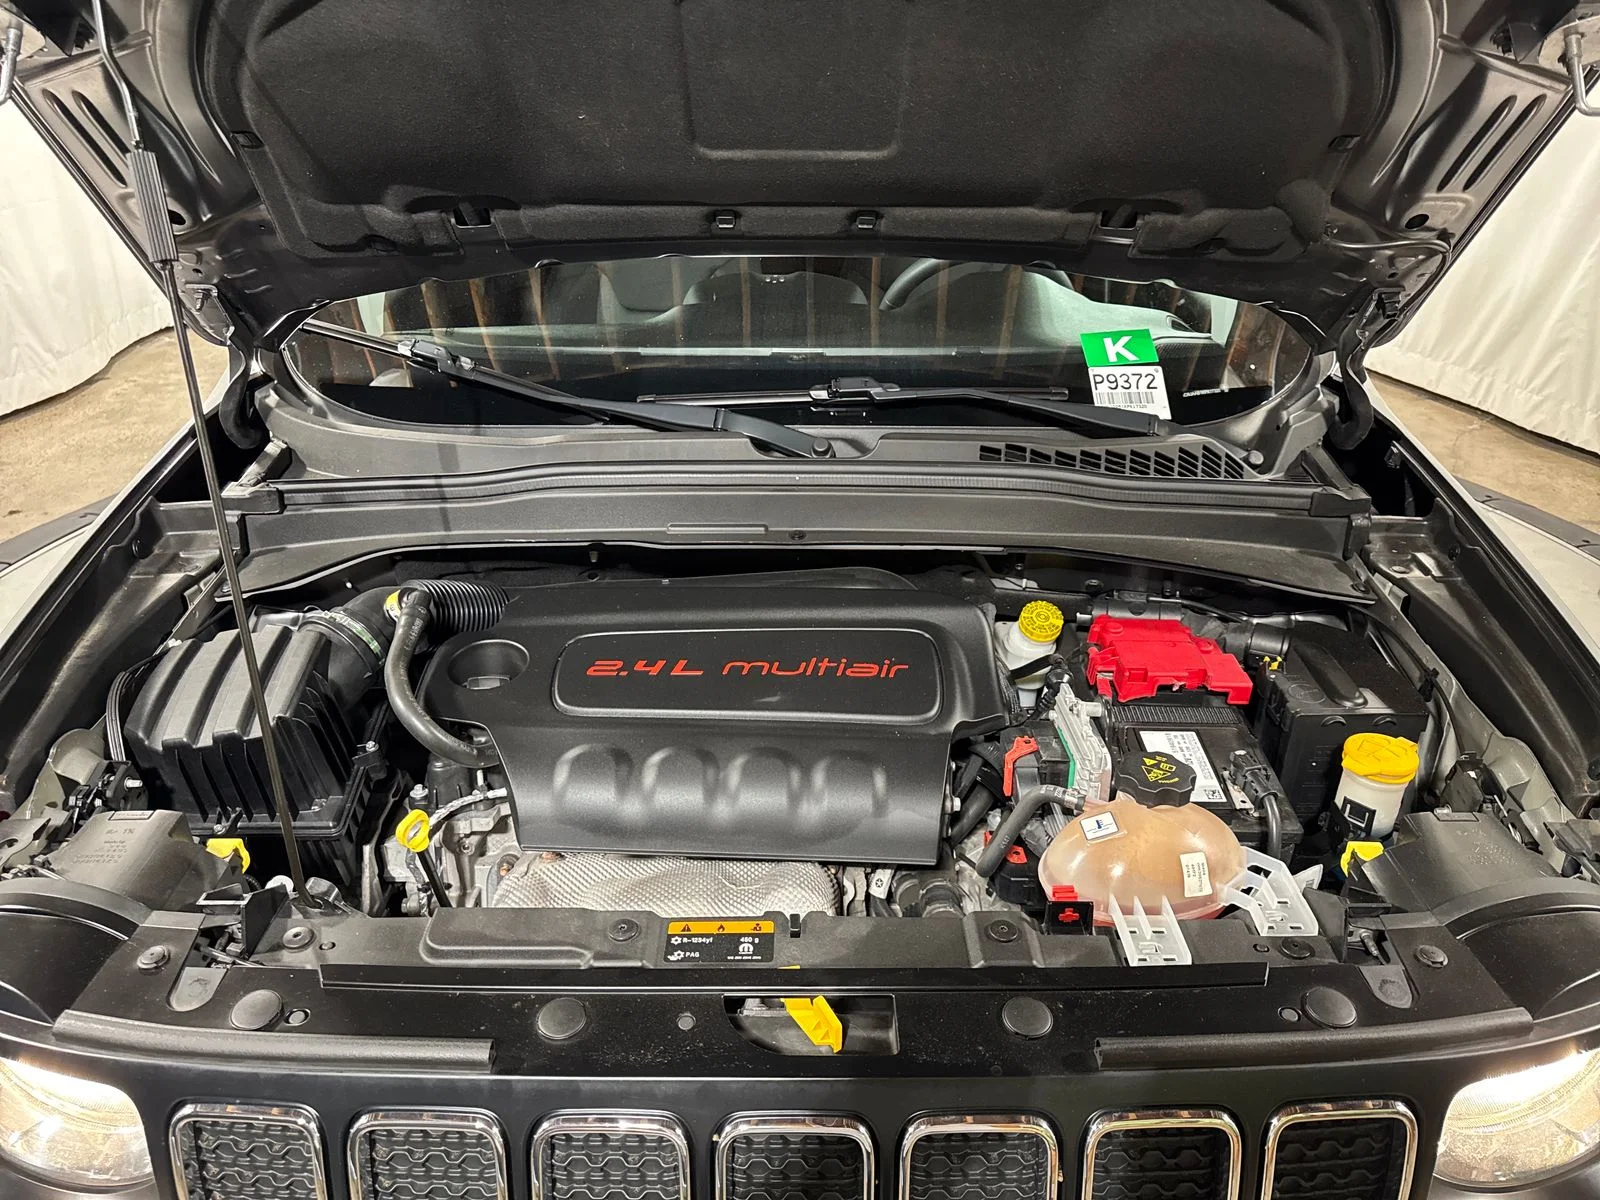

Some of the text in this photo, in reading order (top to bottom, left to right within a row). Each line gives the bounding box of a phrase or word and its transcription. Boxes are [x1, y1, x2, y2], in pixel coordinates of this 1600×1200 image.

[1103, 335, 1140, 363] K
[1092, 373, 1158, 391] P9372
[722, 657, 909, 679] multiair
[682, 936, 714, 945] R-1234yf
